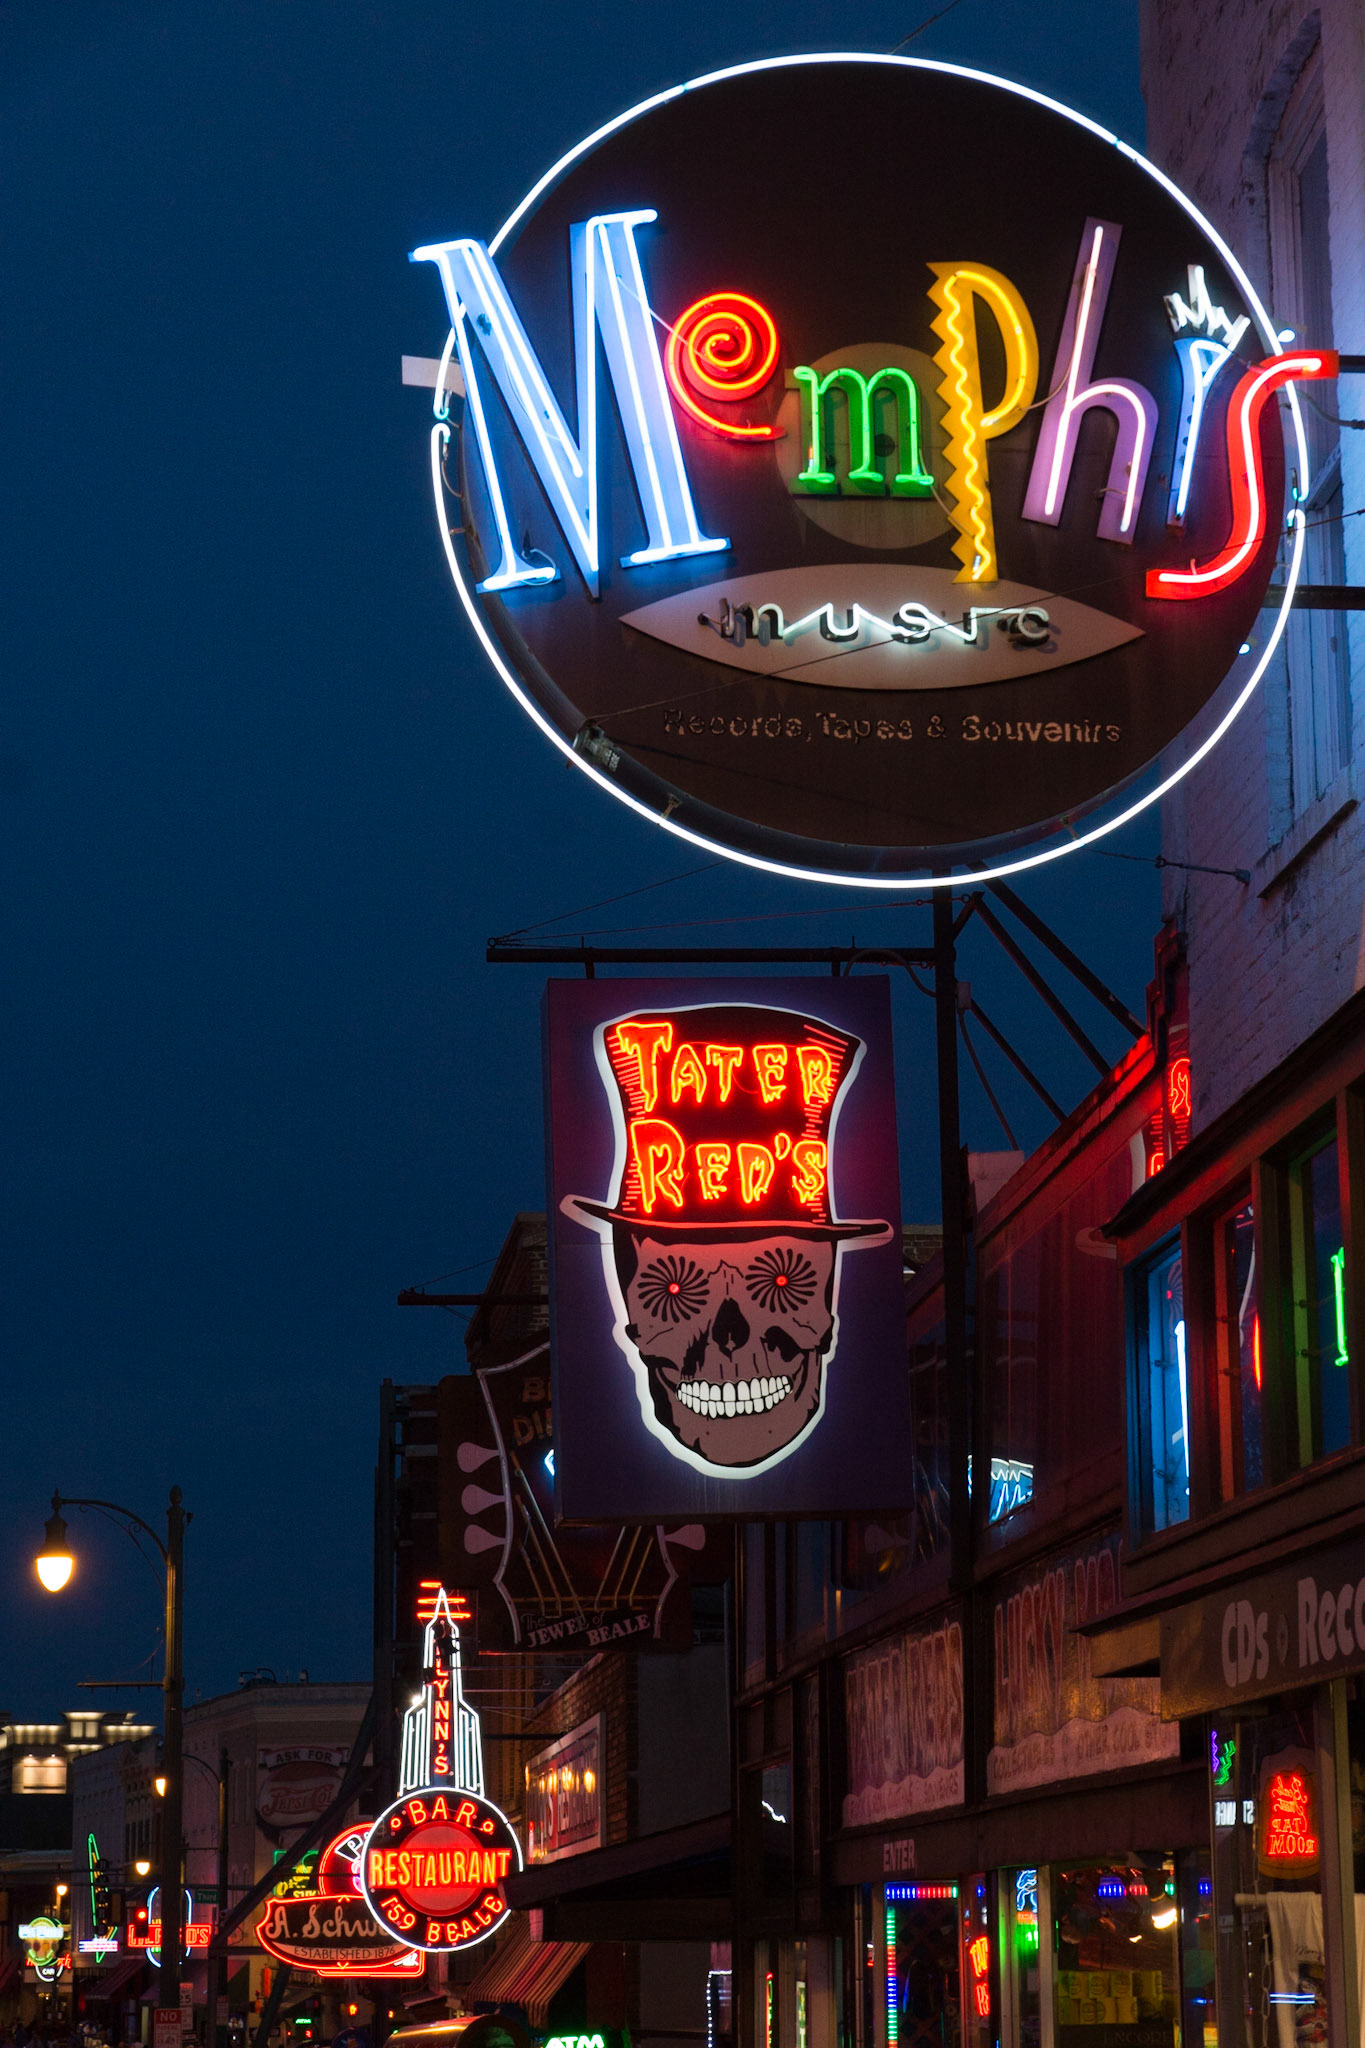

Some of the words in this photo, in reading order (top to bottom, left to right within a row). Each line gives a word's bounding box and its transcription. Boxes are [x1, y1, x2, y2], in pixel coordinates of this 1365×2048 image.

[716, 598, 1049, 645] music
[664, 708, 812, 741] Records,
[816, 712, 912, 745] Tapes
[927, 714, 946, 740] &
[961, 714, 1121, 743] Souvenirs
[526, 1617, 590, 1649] JEWEL
[585, 1613, 652, 1648] BEALE
[1221, 1599, 1269, 1688] CDs
[433, 1643, 450, 1775] LYNN'S
[276, 1751, 301, 1763] ASK
[308, 1750, 333, 1762] FOR
[408, 1795, 478, 1834] BAR
[369, 1849, 512, 1888] RESTAURANT
[883, 1838, 917, 1872] ENTER
[197, 1892, 217, 1903] Third
[265, 1905, 298, 1939] A.
[380, 1896, 417, 1931] 159
[427, 1893, 505, 1944] BEALE
[294, 1947, 371, 1960] ESTABLISHED
[374, 1945, 396, 1959] 1876
[159, 2012, 178, 2022] NO
